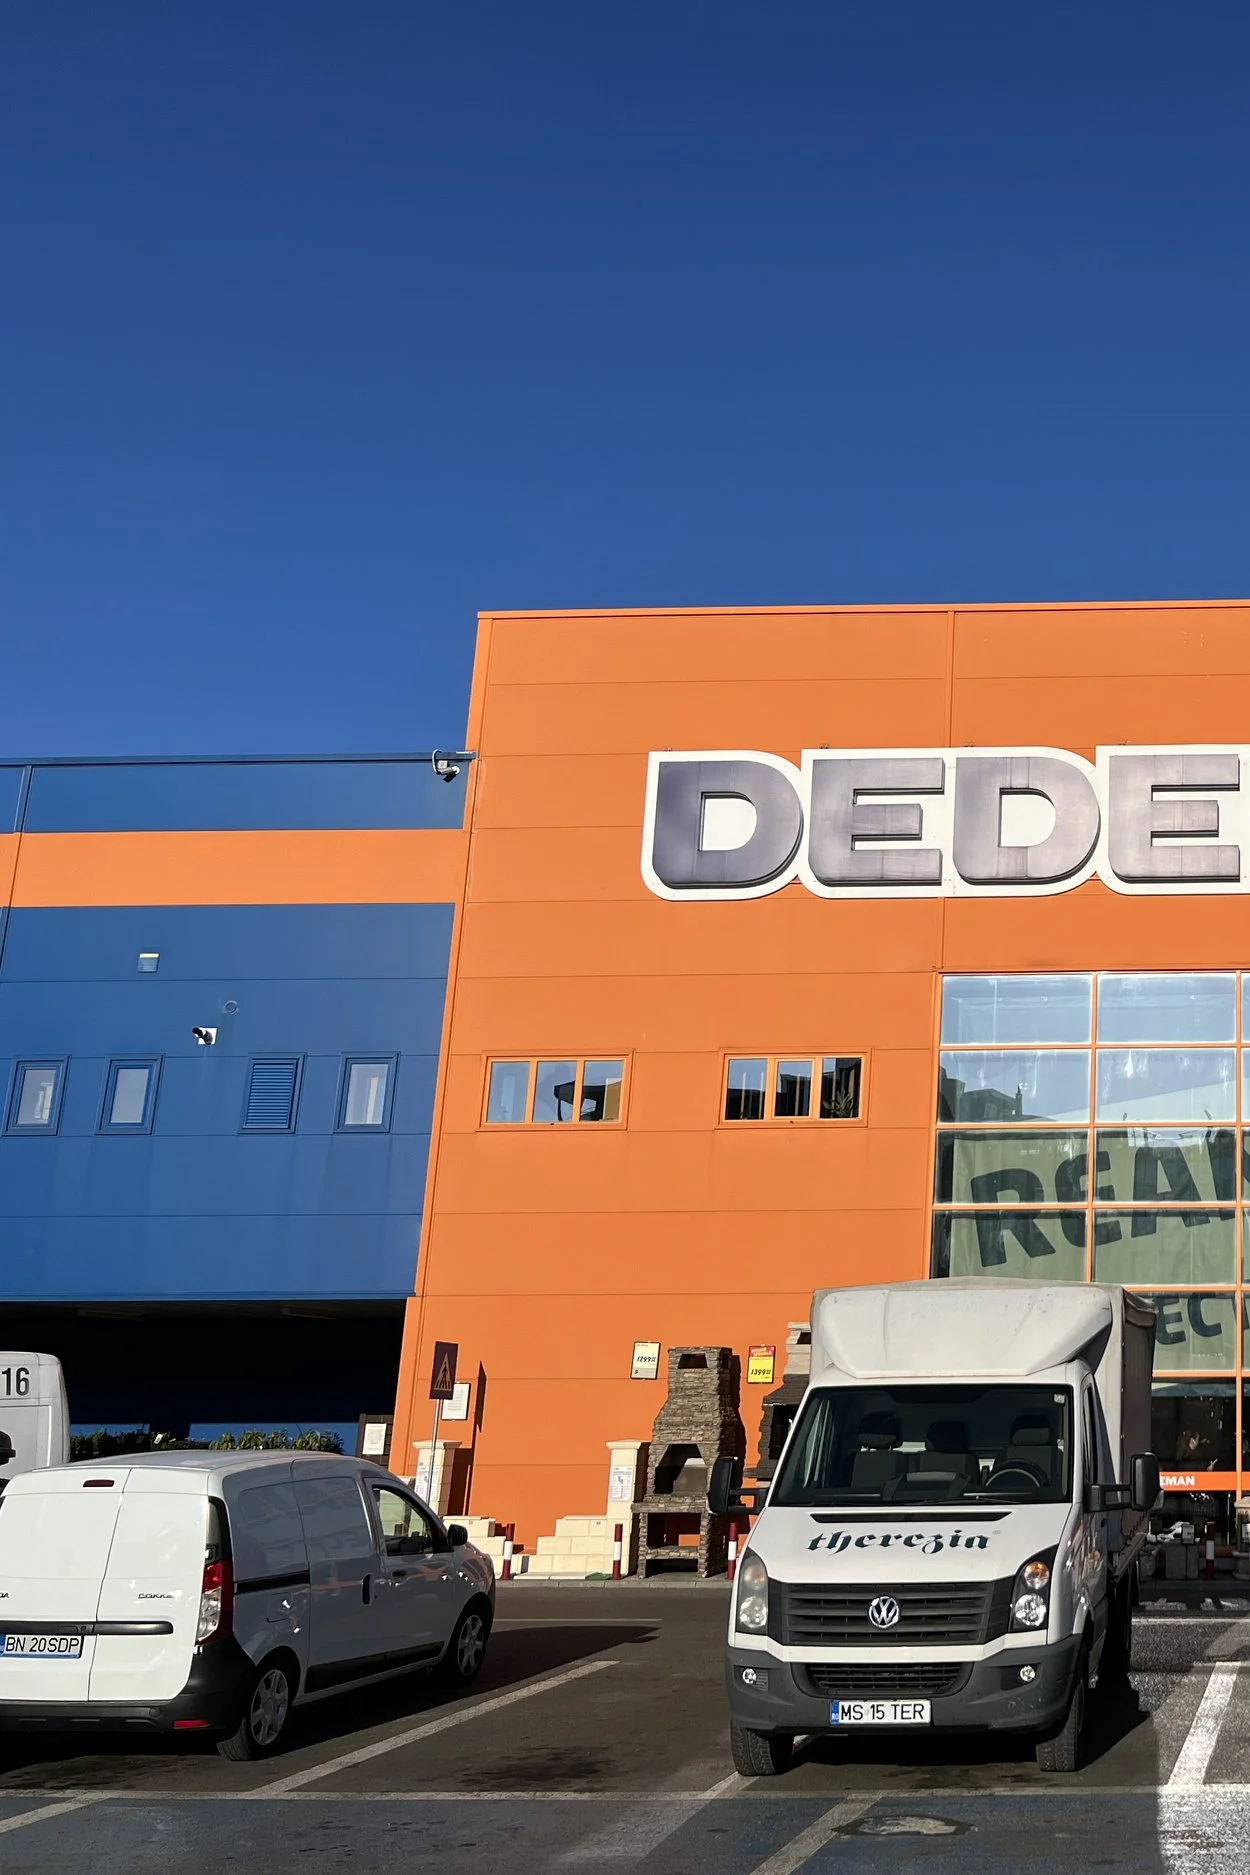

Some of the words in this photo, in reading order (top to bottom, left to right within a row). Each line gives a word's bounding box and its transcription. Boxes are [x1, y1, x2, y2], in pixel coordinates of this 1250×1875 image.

[1, 1367, 30, 1396] 16
[1160, 1475, 1195, 1486] EMAN
[805, 1529, 992, 1556] therezia
[5, 1636, 26, 1653] BN
[841, 1704, 864, 1720] MS
[870, 1704, 885, 1720] 15
[890, 1704, 925, 1720] TER
